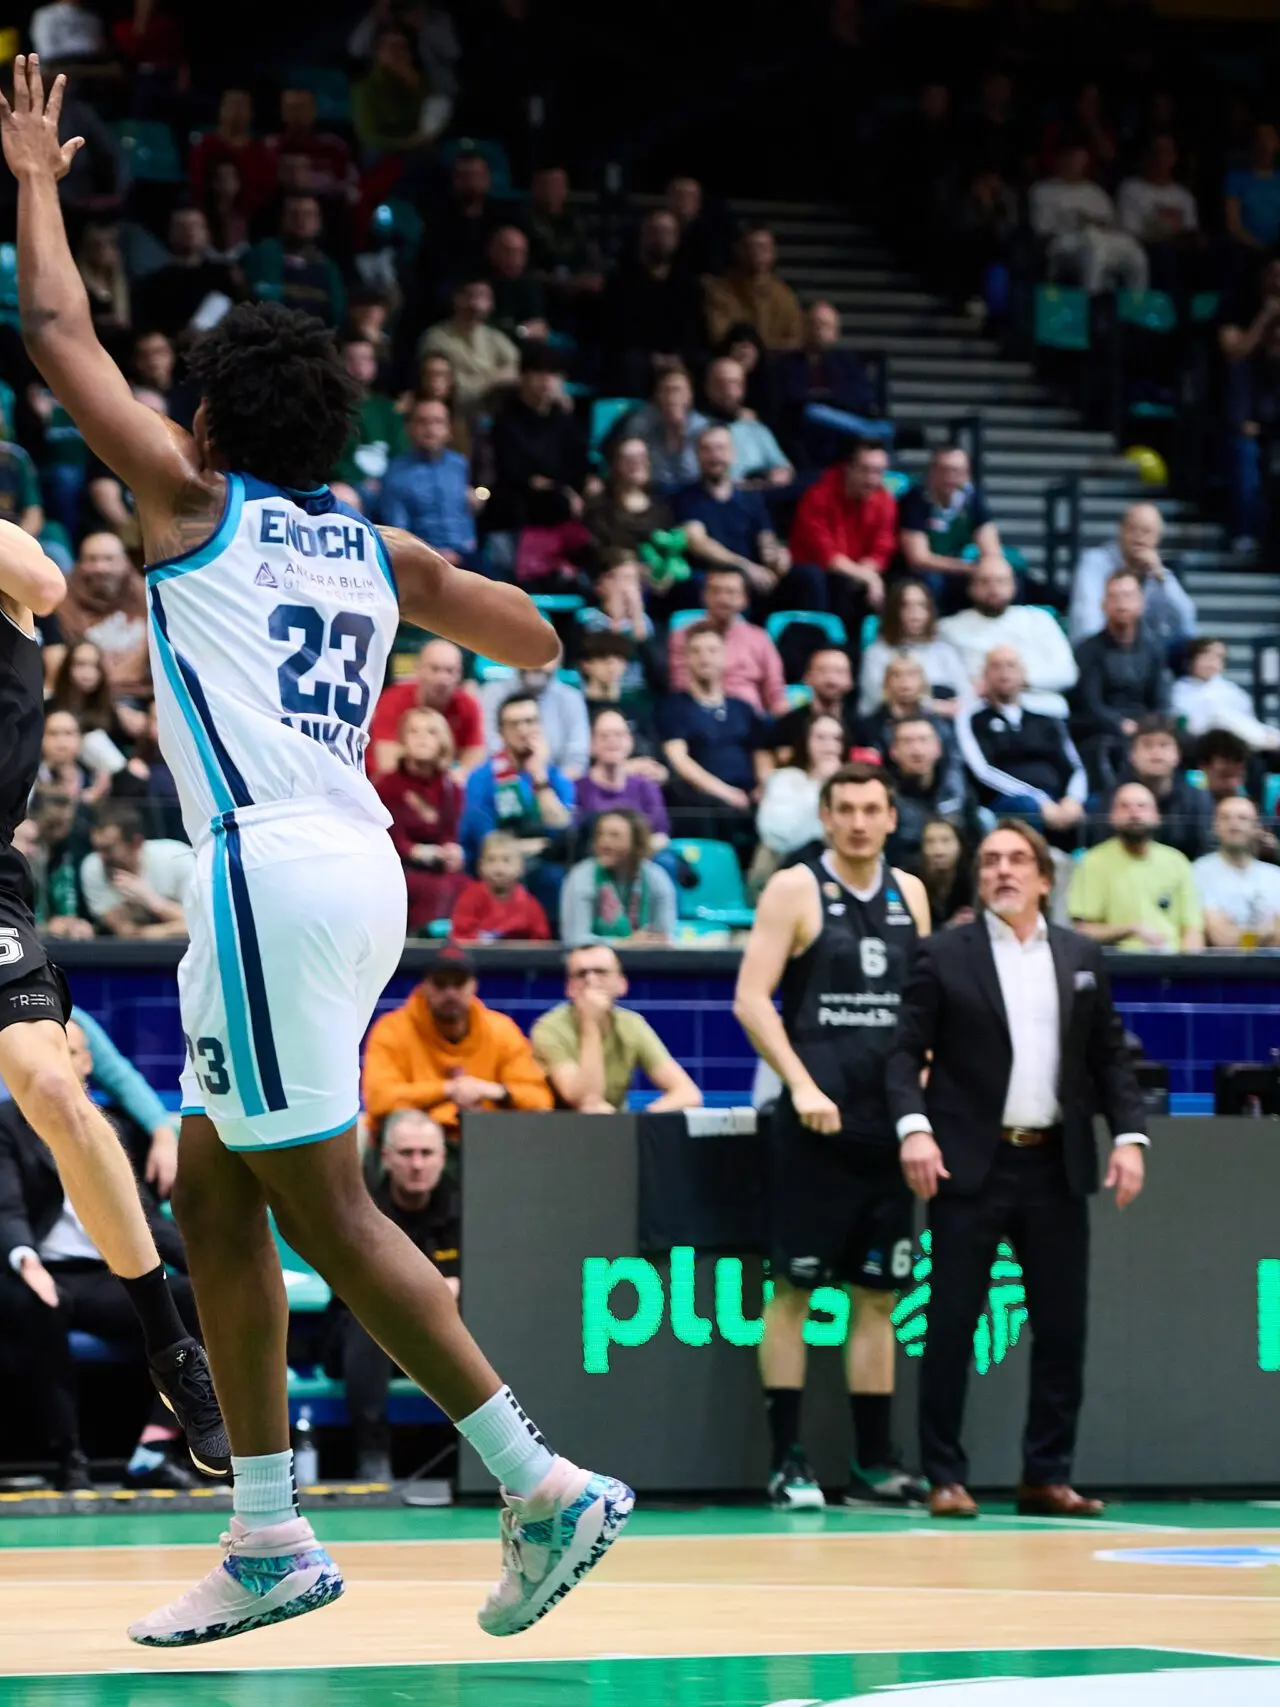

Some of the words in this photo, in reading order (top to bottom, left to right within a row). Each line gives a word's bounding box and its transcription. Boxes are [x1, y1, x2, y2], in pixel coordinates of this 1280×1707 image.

[260, 509, 365, 561] ENOCH
[268, 604, 375, 728] 23
[860, 936, 888, 978] 6
[184, 1033, 231, 1095] 3
[891, 1239, 912, 1278] 6
